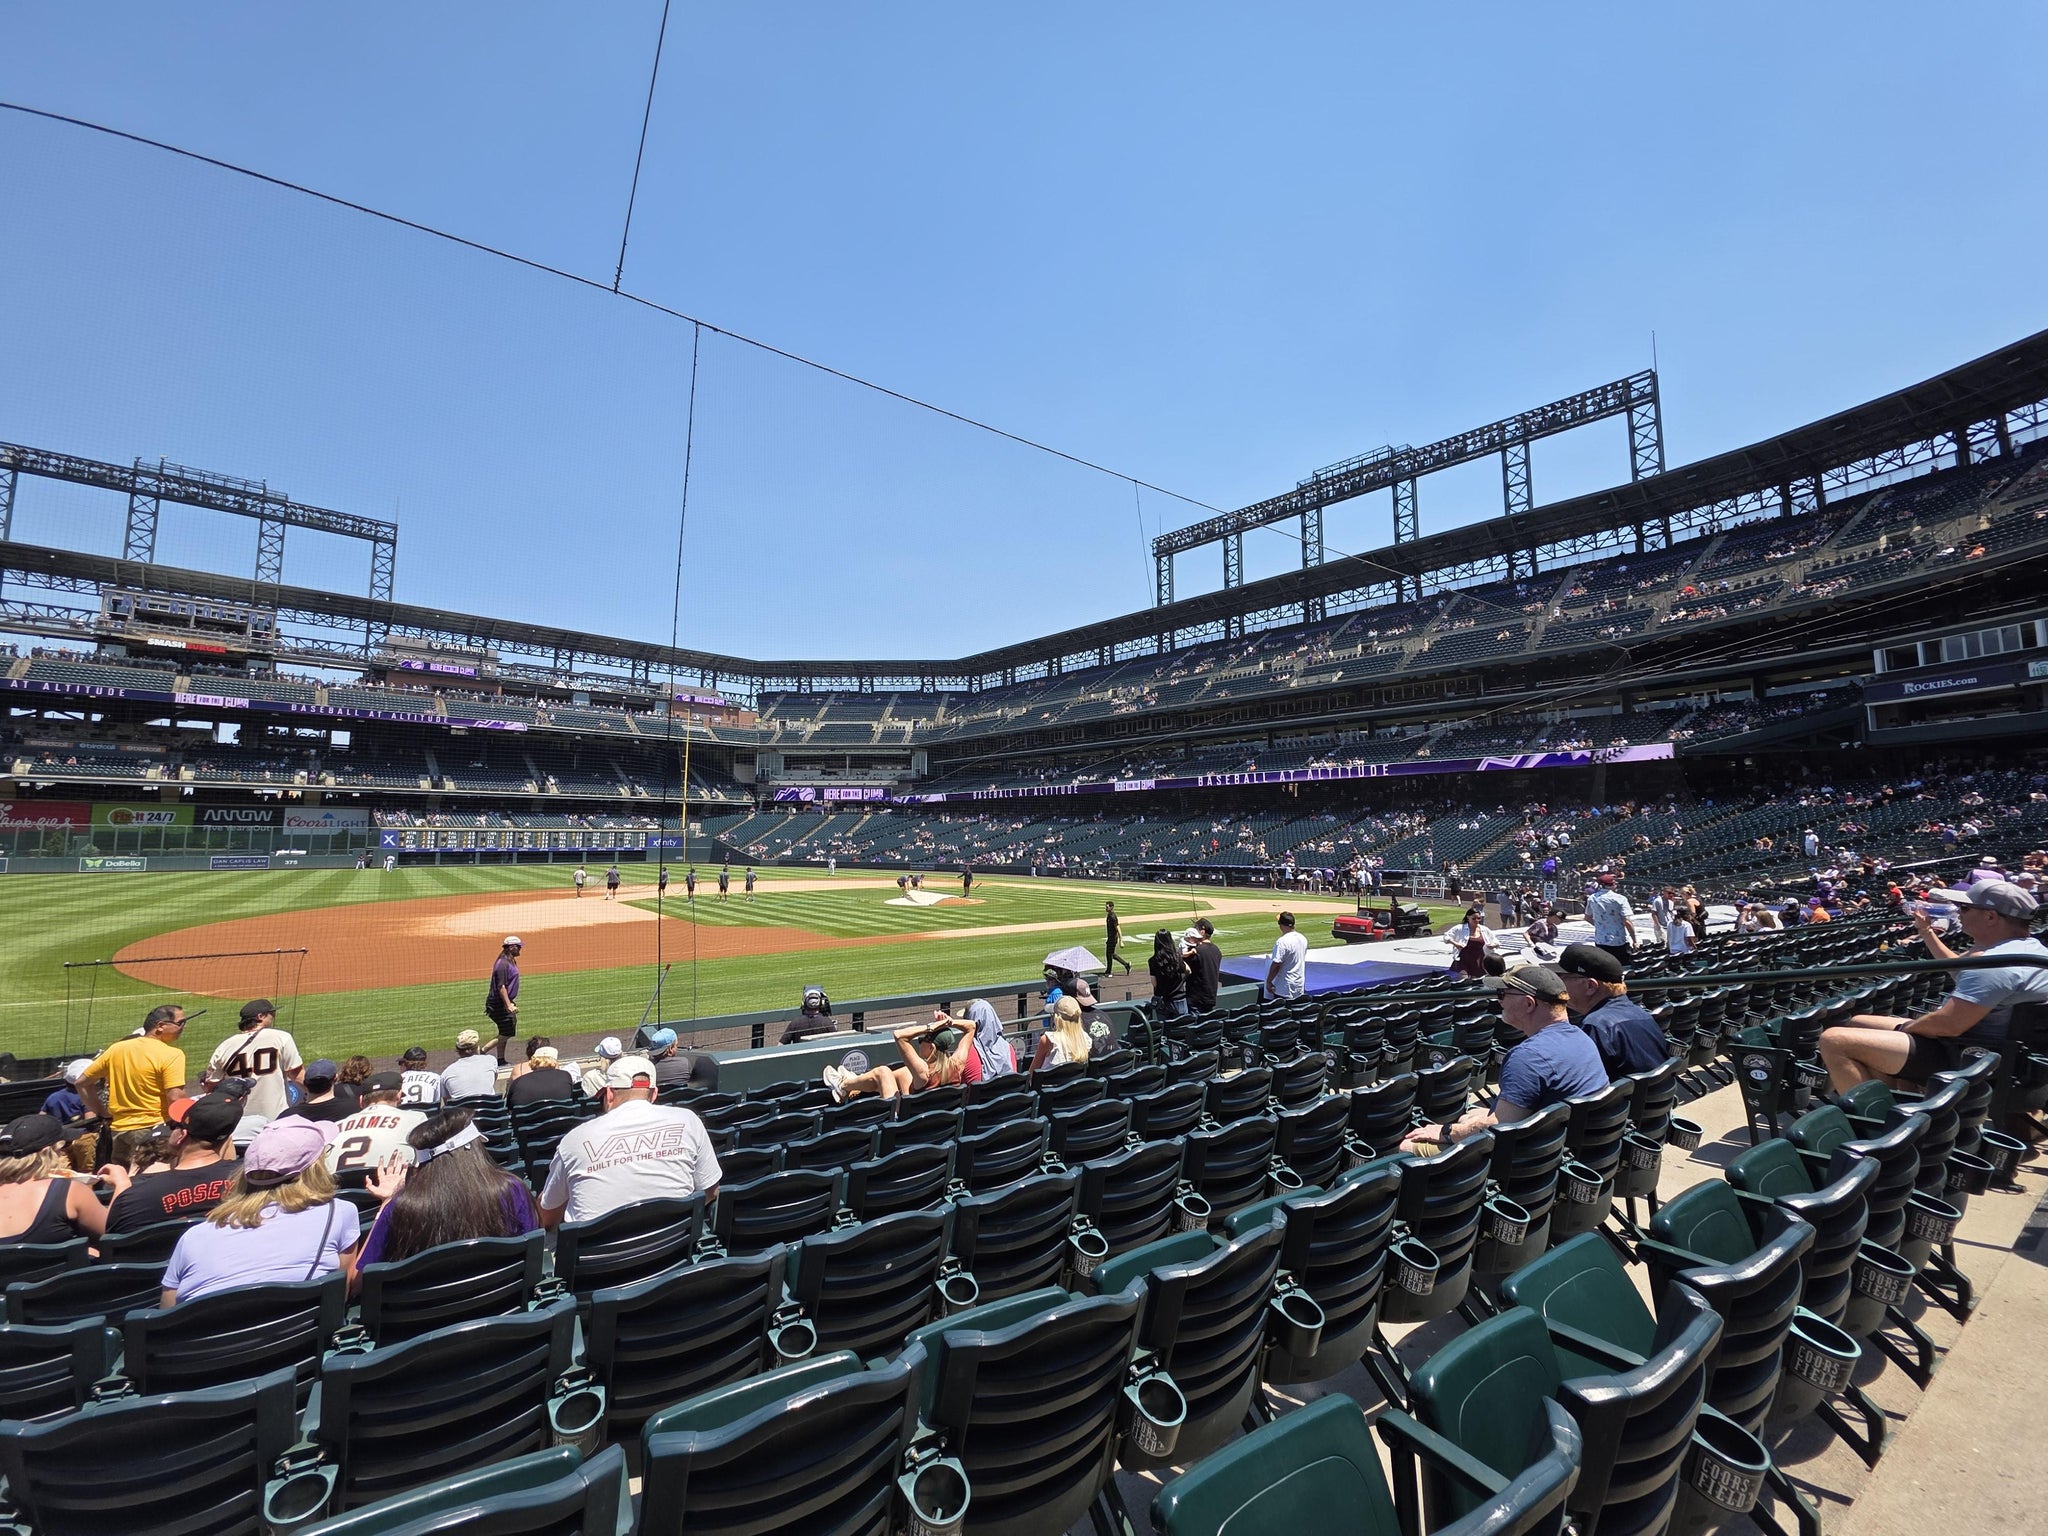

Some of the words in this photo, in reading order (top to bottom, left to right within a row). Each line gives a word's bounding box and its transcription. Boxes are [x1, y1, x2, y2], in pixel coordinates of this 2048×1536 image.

[10, 680, 29, 689] AT
[42, 682, 126, 697] ALTITUDE
[1902, 677, 1978, 695] ROCKIES.com
[291, 703, 360, 717] BASEBALL
[368, 710, 382, 718] AT
[391, 712, 449, 724] ALTITUDE
[1197, 771, 1269, 787] BASEBALL
[1279, 769, 1296, 782] AT
[1307, 763, 1389, 780] ALTITUDE
[823, 788, 841, 800] HERE
[972, 788, 1013, 800] BASEBALL
[1018, 787, 1028, 797] AT
[1033, 785, 1079, 797] ALTITUDE
[146, 812, 176, 822] 24/7
[203, 809, 273, 822] ARROW
[286, 815, 329, 828] Coors
[329, 819, 367, 828] LIGHT
[105, 860, 141, 868] DaBella
[227, 1047, 279, 1079] 40
[336, 1135, 372, 1171] 2
[582, 1123, 686, 1163] VANS
[587, 1159, 611, 1173] BUILT
[613, 1156, 633, 1166] FOR
[636, 1152, 654, 1161] THE
[655, 1147, 684, 1158] BEACH
[162, 1180, 237, 1214] POSEY
[1495, 1217, 1518, 1235] COORS
[1913, 1222, 1946, 1242] FIELD
[1915, 1212, 1949, 1232] COORS
[1494, 1225, 1517, 1243] FIELD
[1399, 1273, 1423, 1293] FIELD
[1400, 1263, 1424, 1283] COORS
[1862, 1266, 1900, 1290] COORS
[1859, 1277, 1897, 1301] FIELD
[1798, 1345, 1840, 1375] COORS
[1794, 1357, 1837, 1388] FIELD
[1701, 1457, 1750, 1493] COORS
[1697, 1471, 1746, 1508] FIELD
